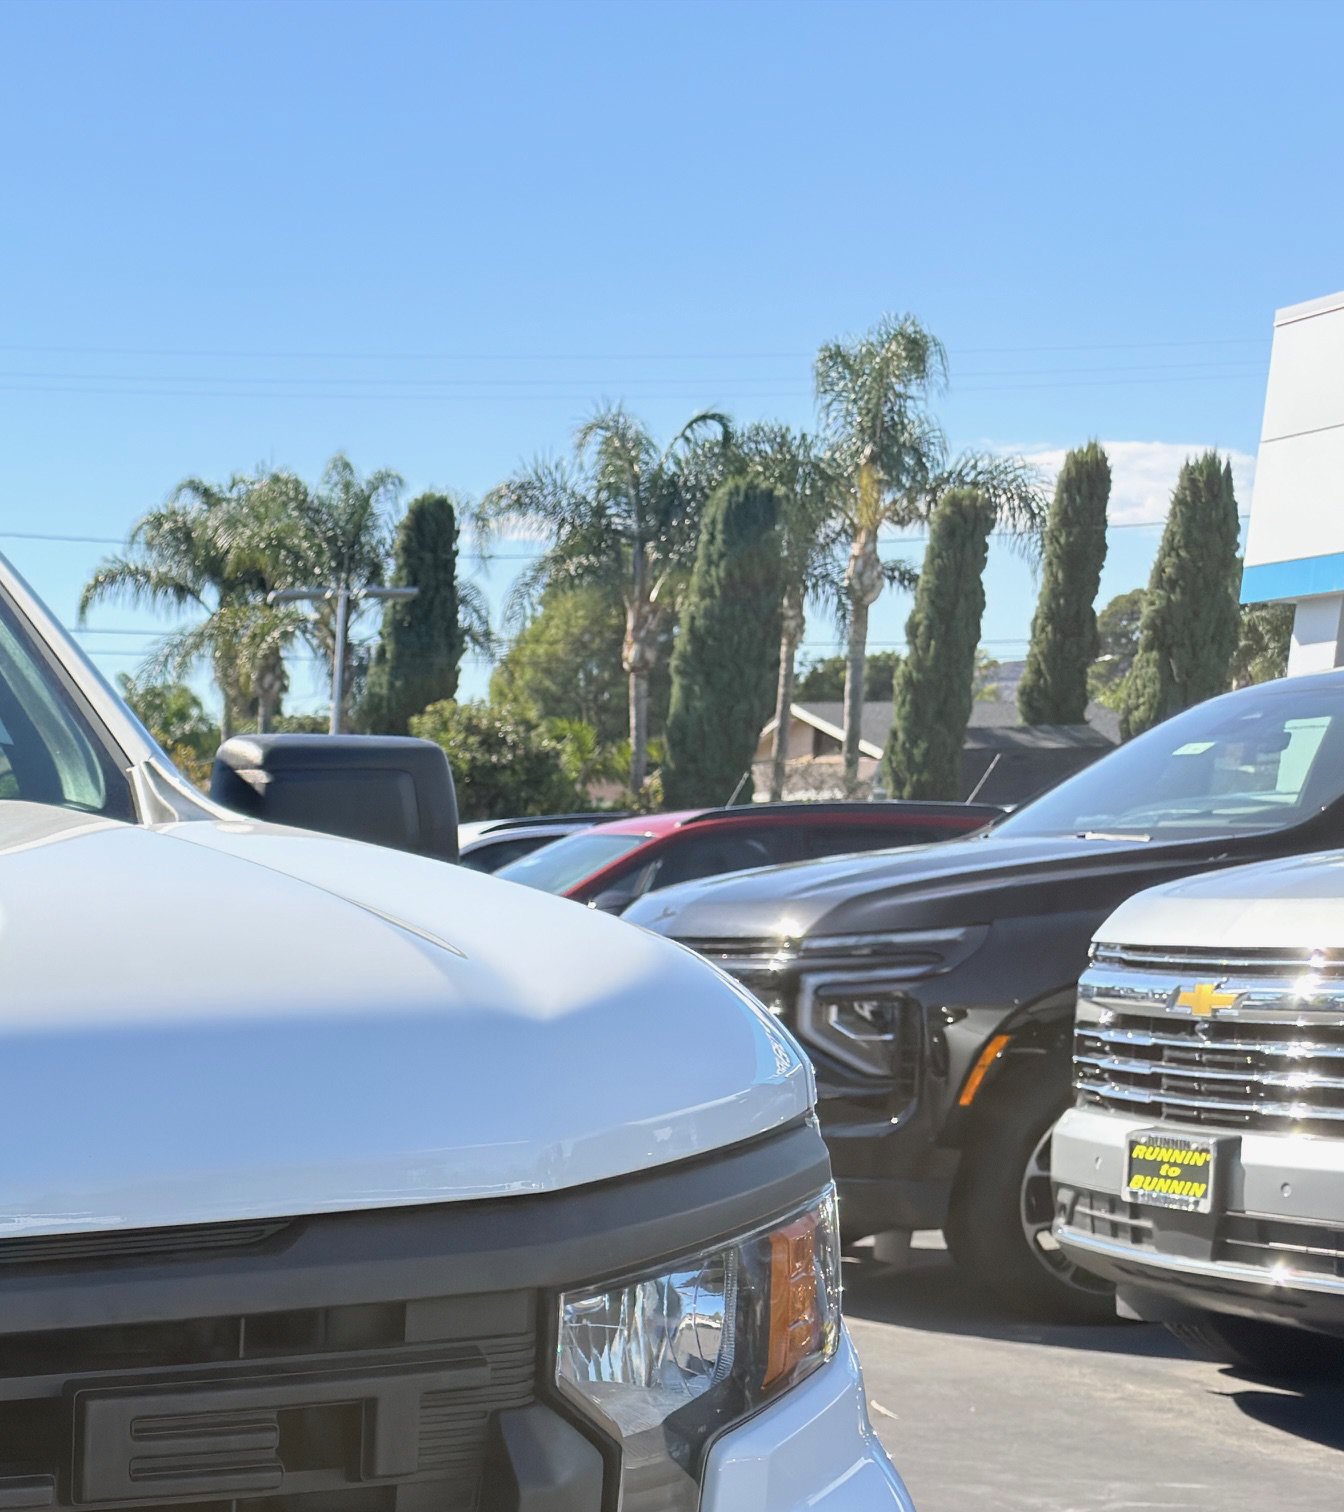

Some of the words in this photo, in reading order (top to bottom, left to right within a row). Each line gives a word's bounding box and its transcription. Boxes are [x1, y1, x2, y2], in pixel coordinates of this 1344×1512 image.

[1132, 1144, 1212, 1166] RUNNIN'
[1159, 1163, 1181, 1177] to
[1129, 1174, 1207, 1198] BUNNIN
